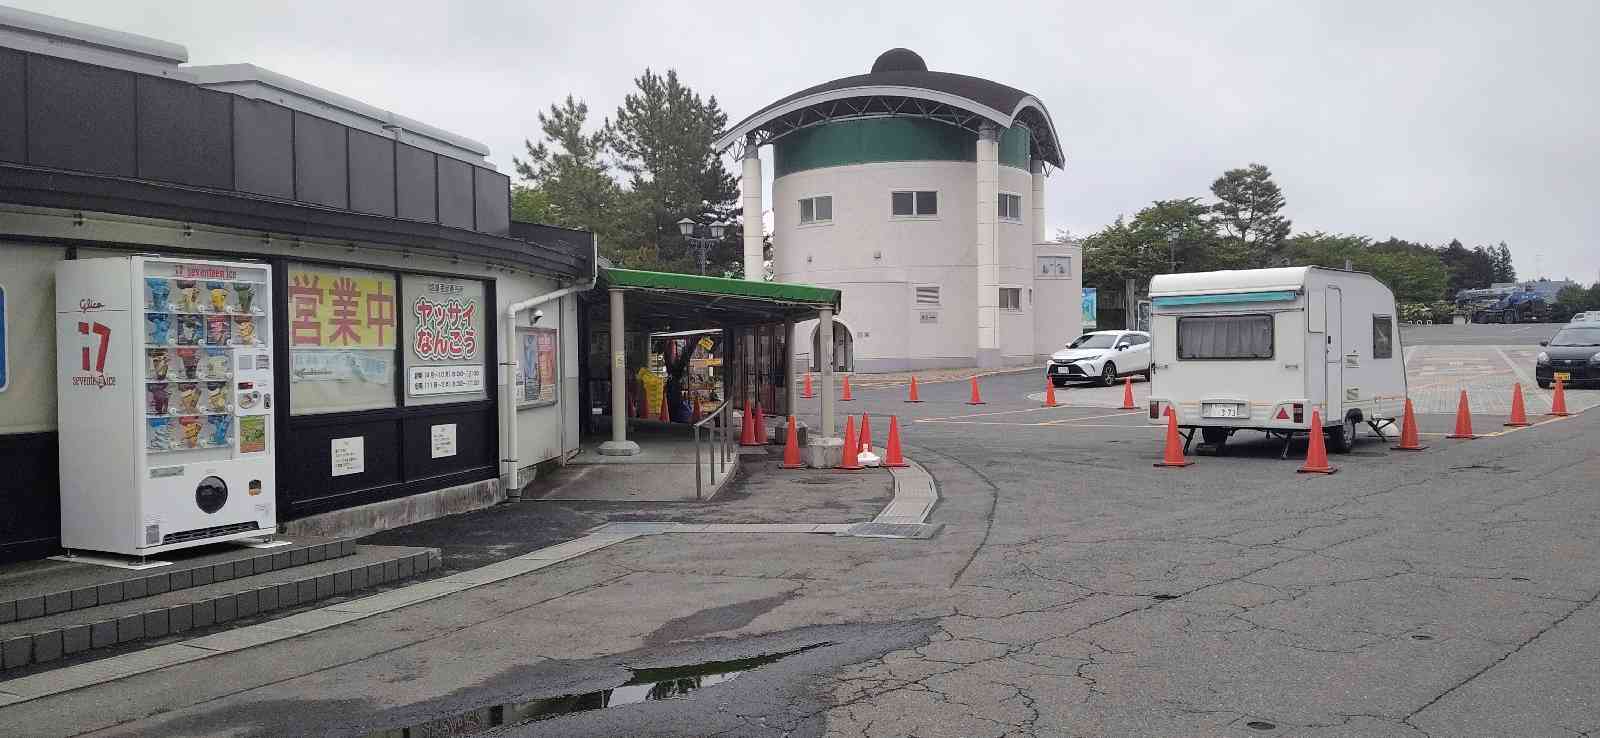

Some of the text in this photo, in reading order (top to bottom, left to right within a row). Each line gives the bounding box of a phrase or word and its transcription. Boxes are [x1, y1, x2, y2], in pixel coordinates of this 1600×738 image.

[80, 299, 104, 313] Glico
[288, 274, 395, 346] 営業中
[416, 301, 475, 327] ヤッサイ
